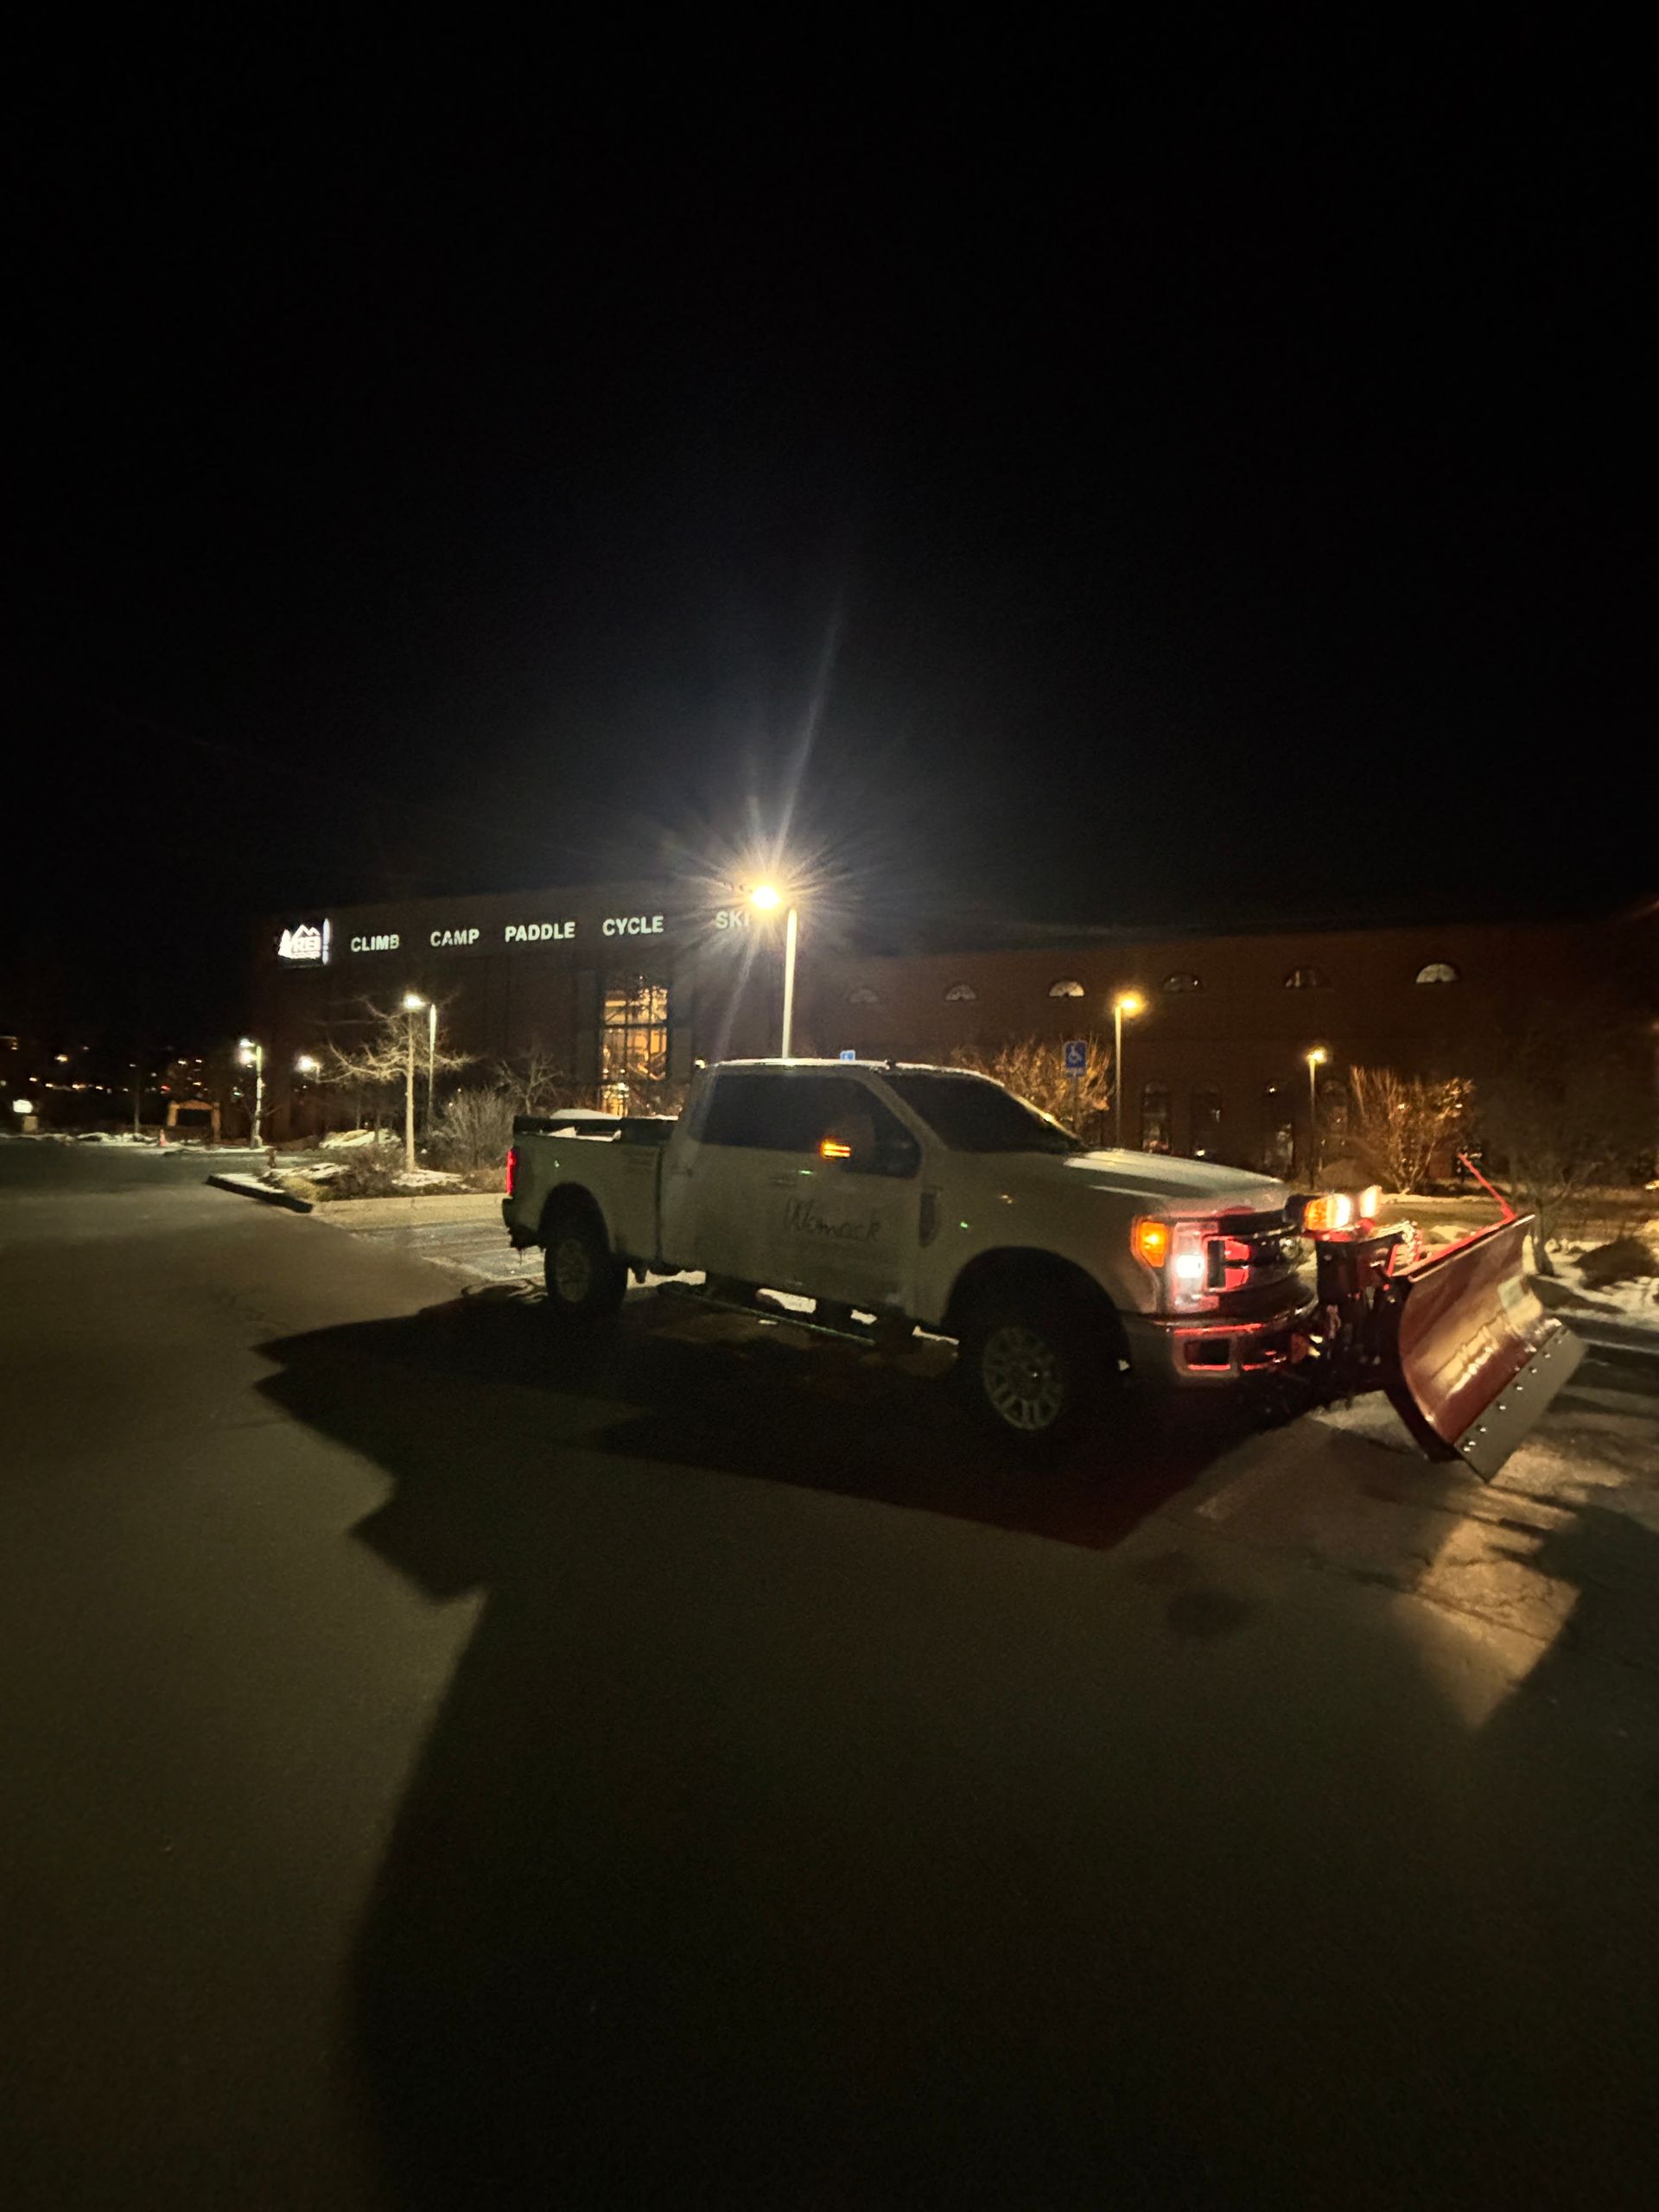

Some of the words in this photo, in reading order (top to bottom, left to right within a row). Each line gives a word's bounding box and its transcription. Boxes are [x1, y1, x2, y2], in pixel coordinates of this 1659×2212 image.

[350, 934, 400, 952] CLIMB
[429, 929, 480, 947] CAMP
[505, 922, 575, 943] PADDLE
[602, 915, 664, 936] CYCLE
